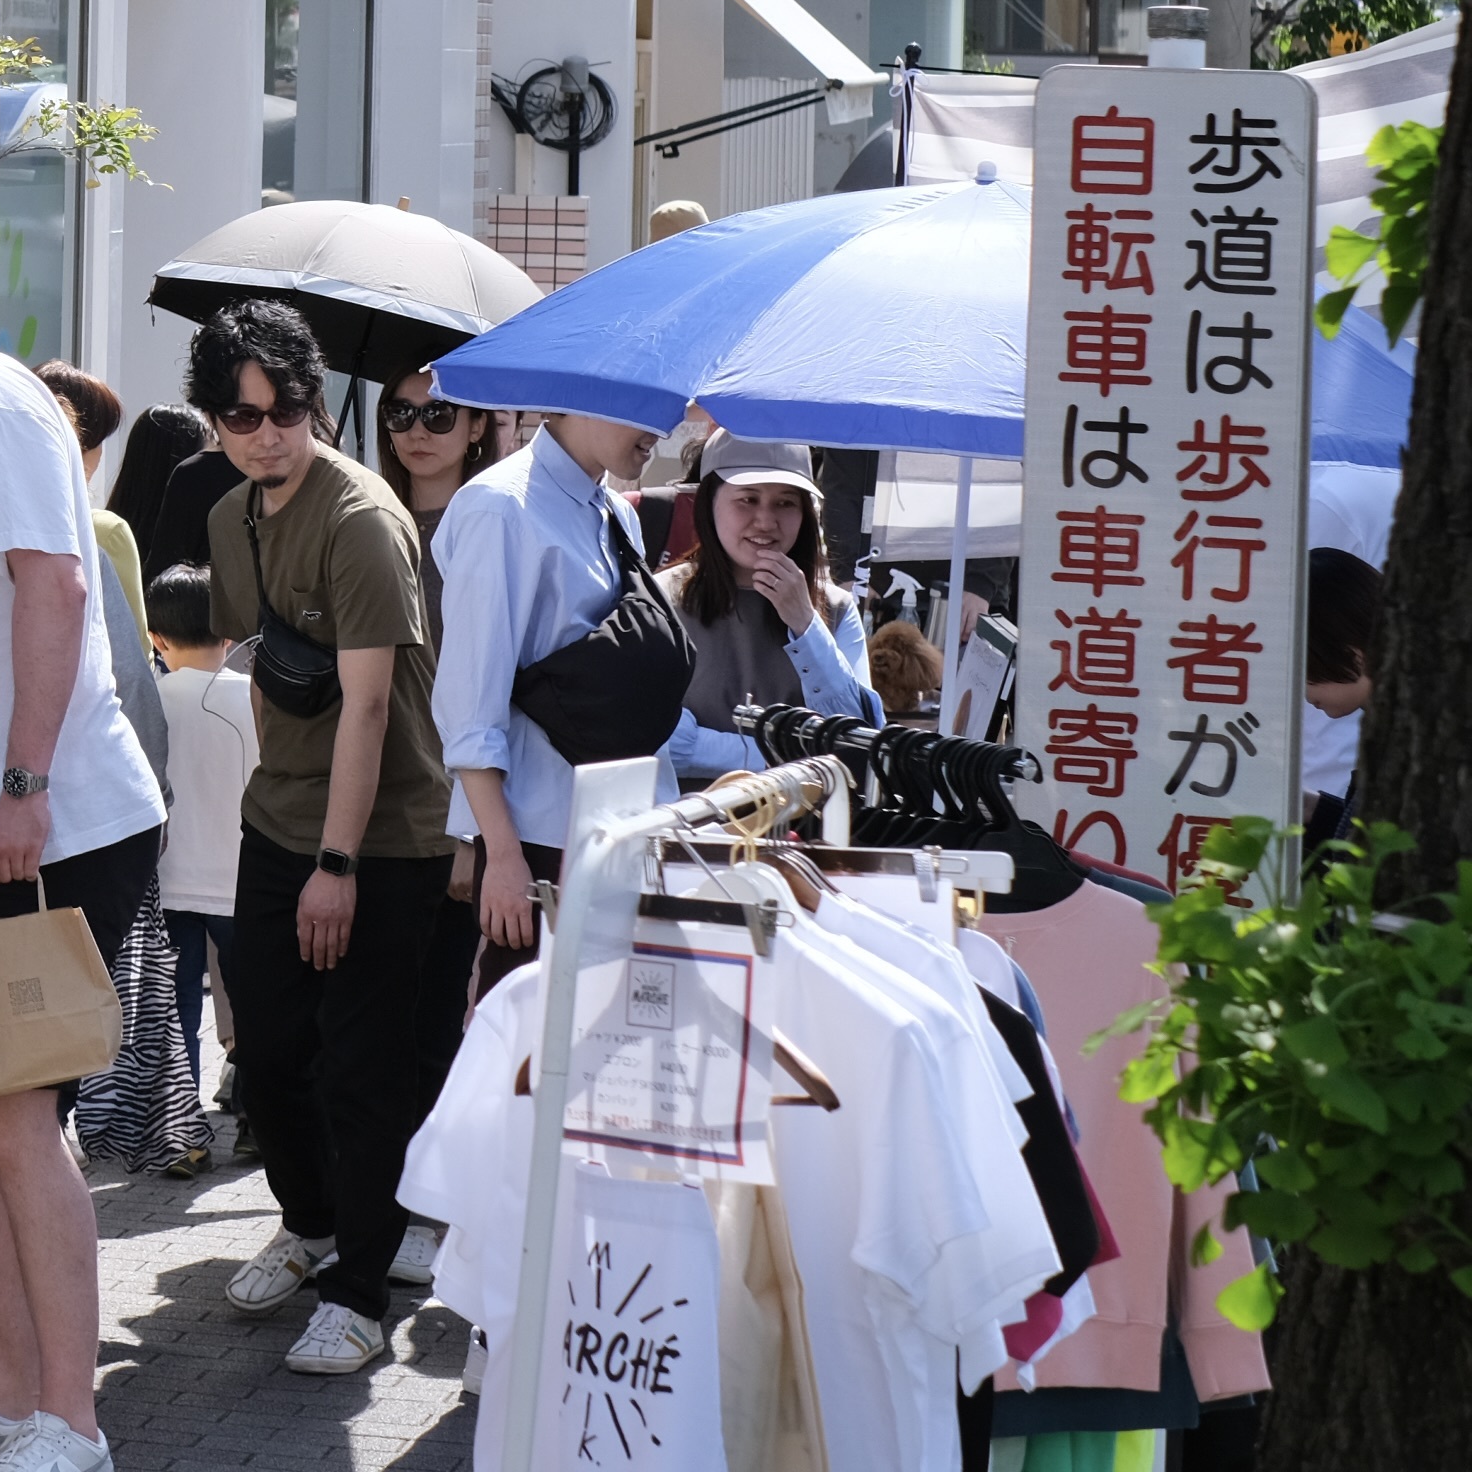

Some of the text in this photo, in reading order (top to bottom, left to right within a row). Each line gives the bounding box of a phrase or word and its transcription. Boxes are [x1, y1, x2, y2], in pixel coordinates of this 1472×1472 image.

[1047, 105, 1157, 868] 自転車は車道寄り
